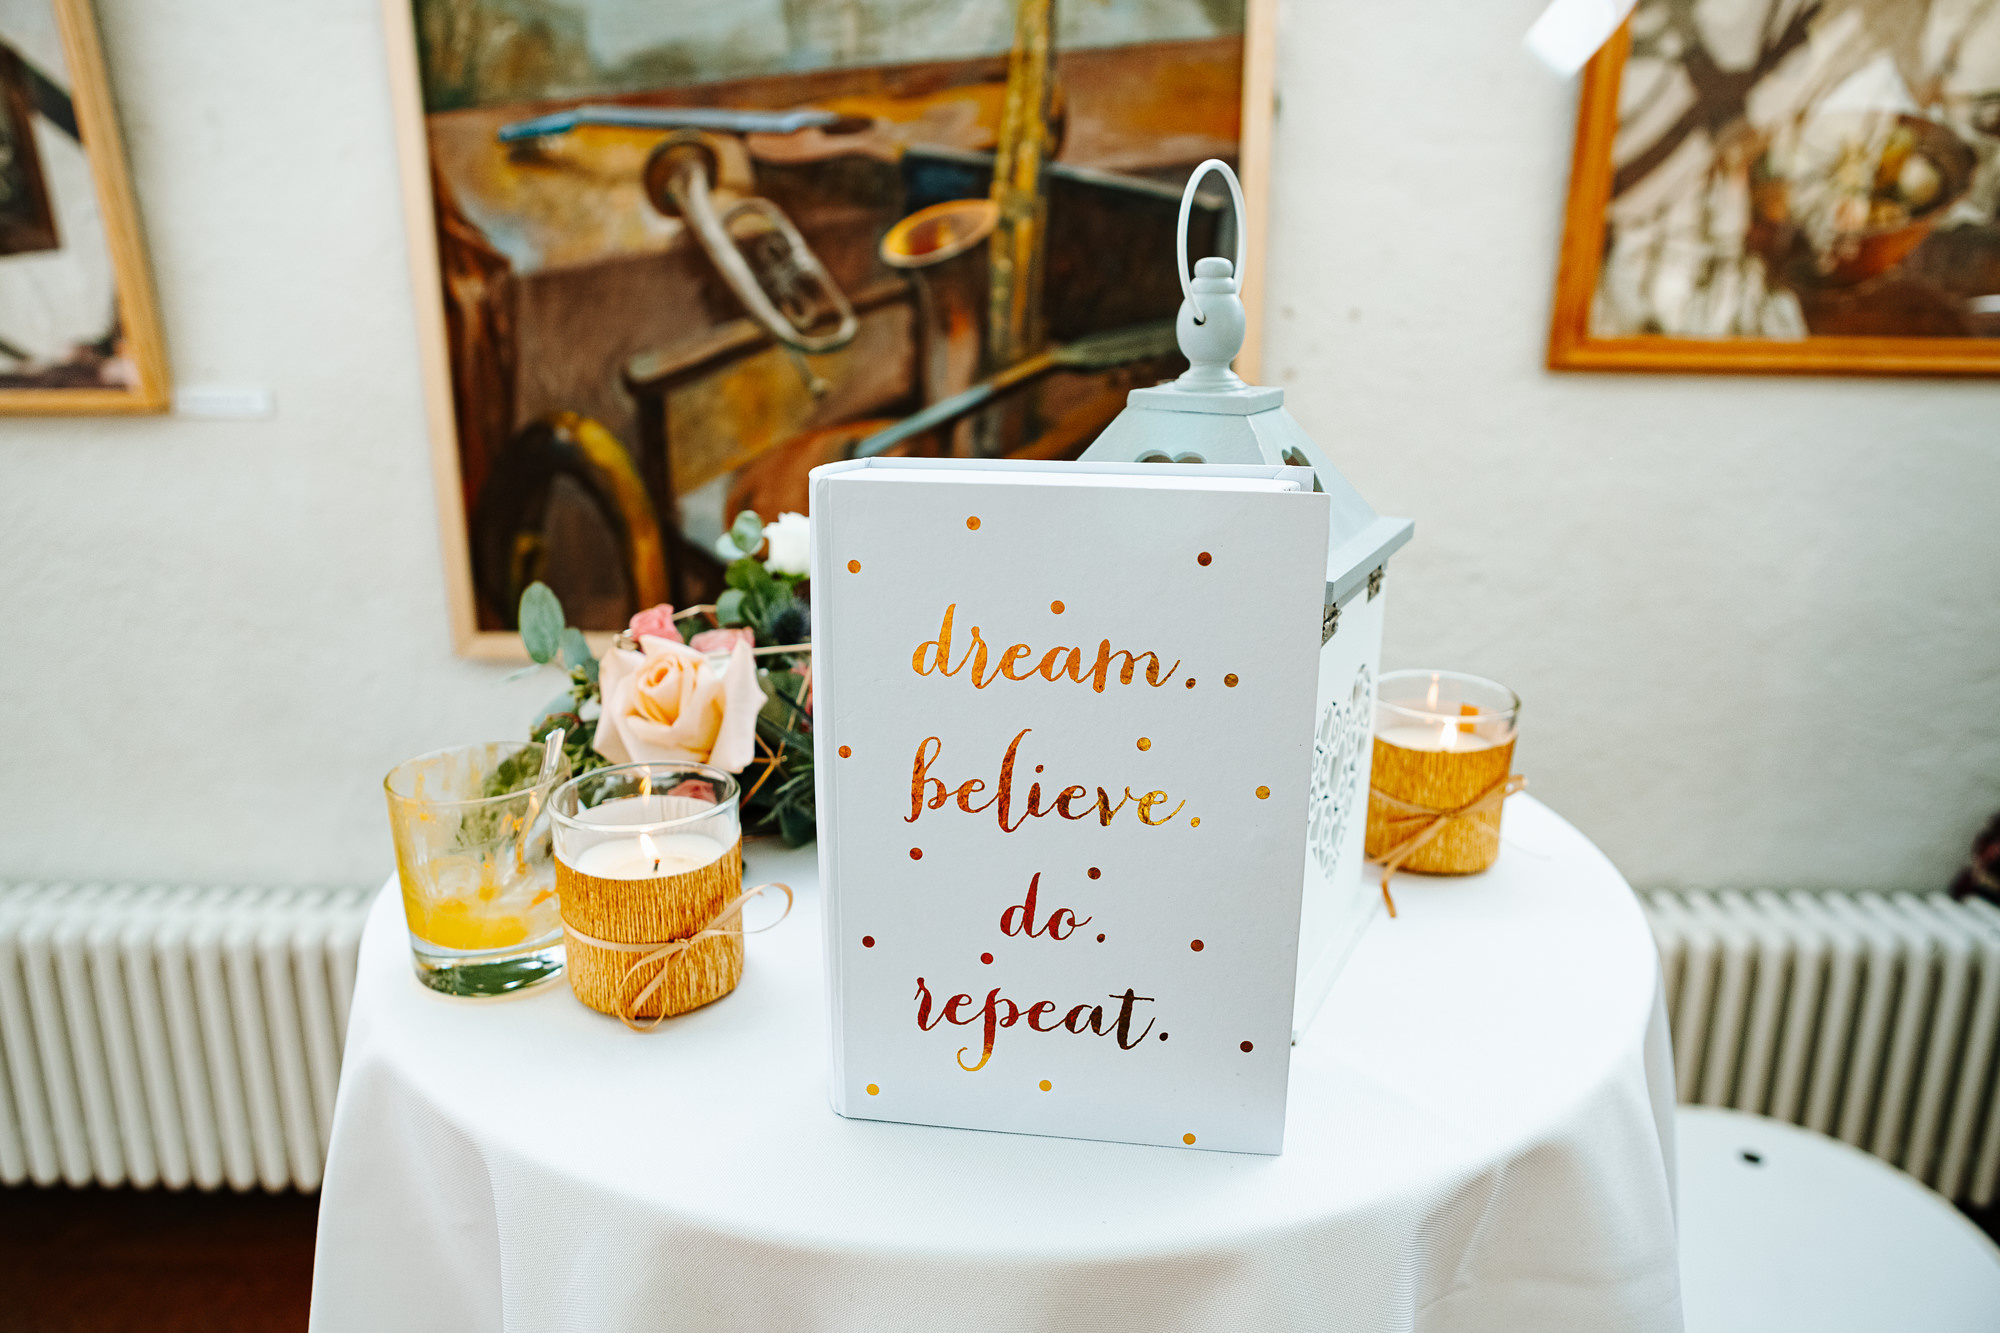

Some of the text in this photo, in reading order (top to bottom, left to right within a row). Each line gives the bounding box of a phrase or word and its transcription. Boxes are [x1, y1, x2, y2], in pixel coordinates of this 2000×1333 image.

[911, 603, 1197, 694] dream.
[903, 728, 1201, 834] believe.
[999, 871, 1106, 944] do.
[913, 977, 1169, 1072] repeat.
